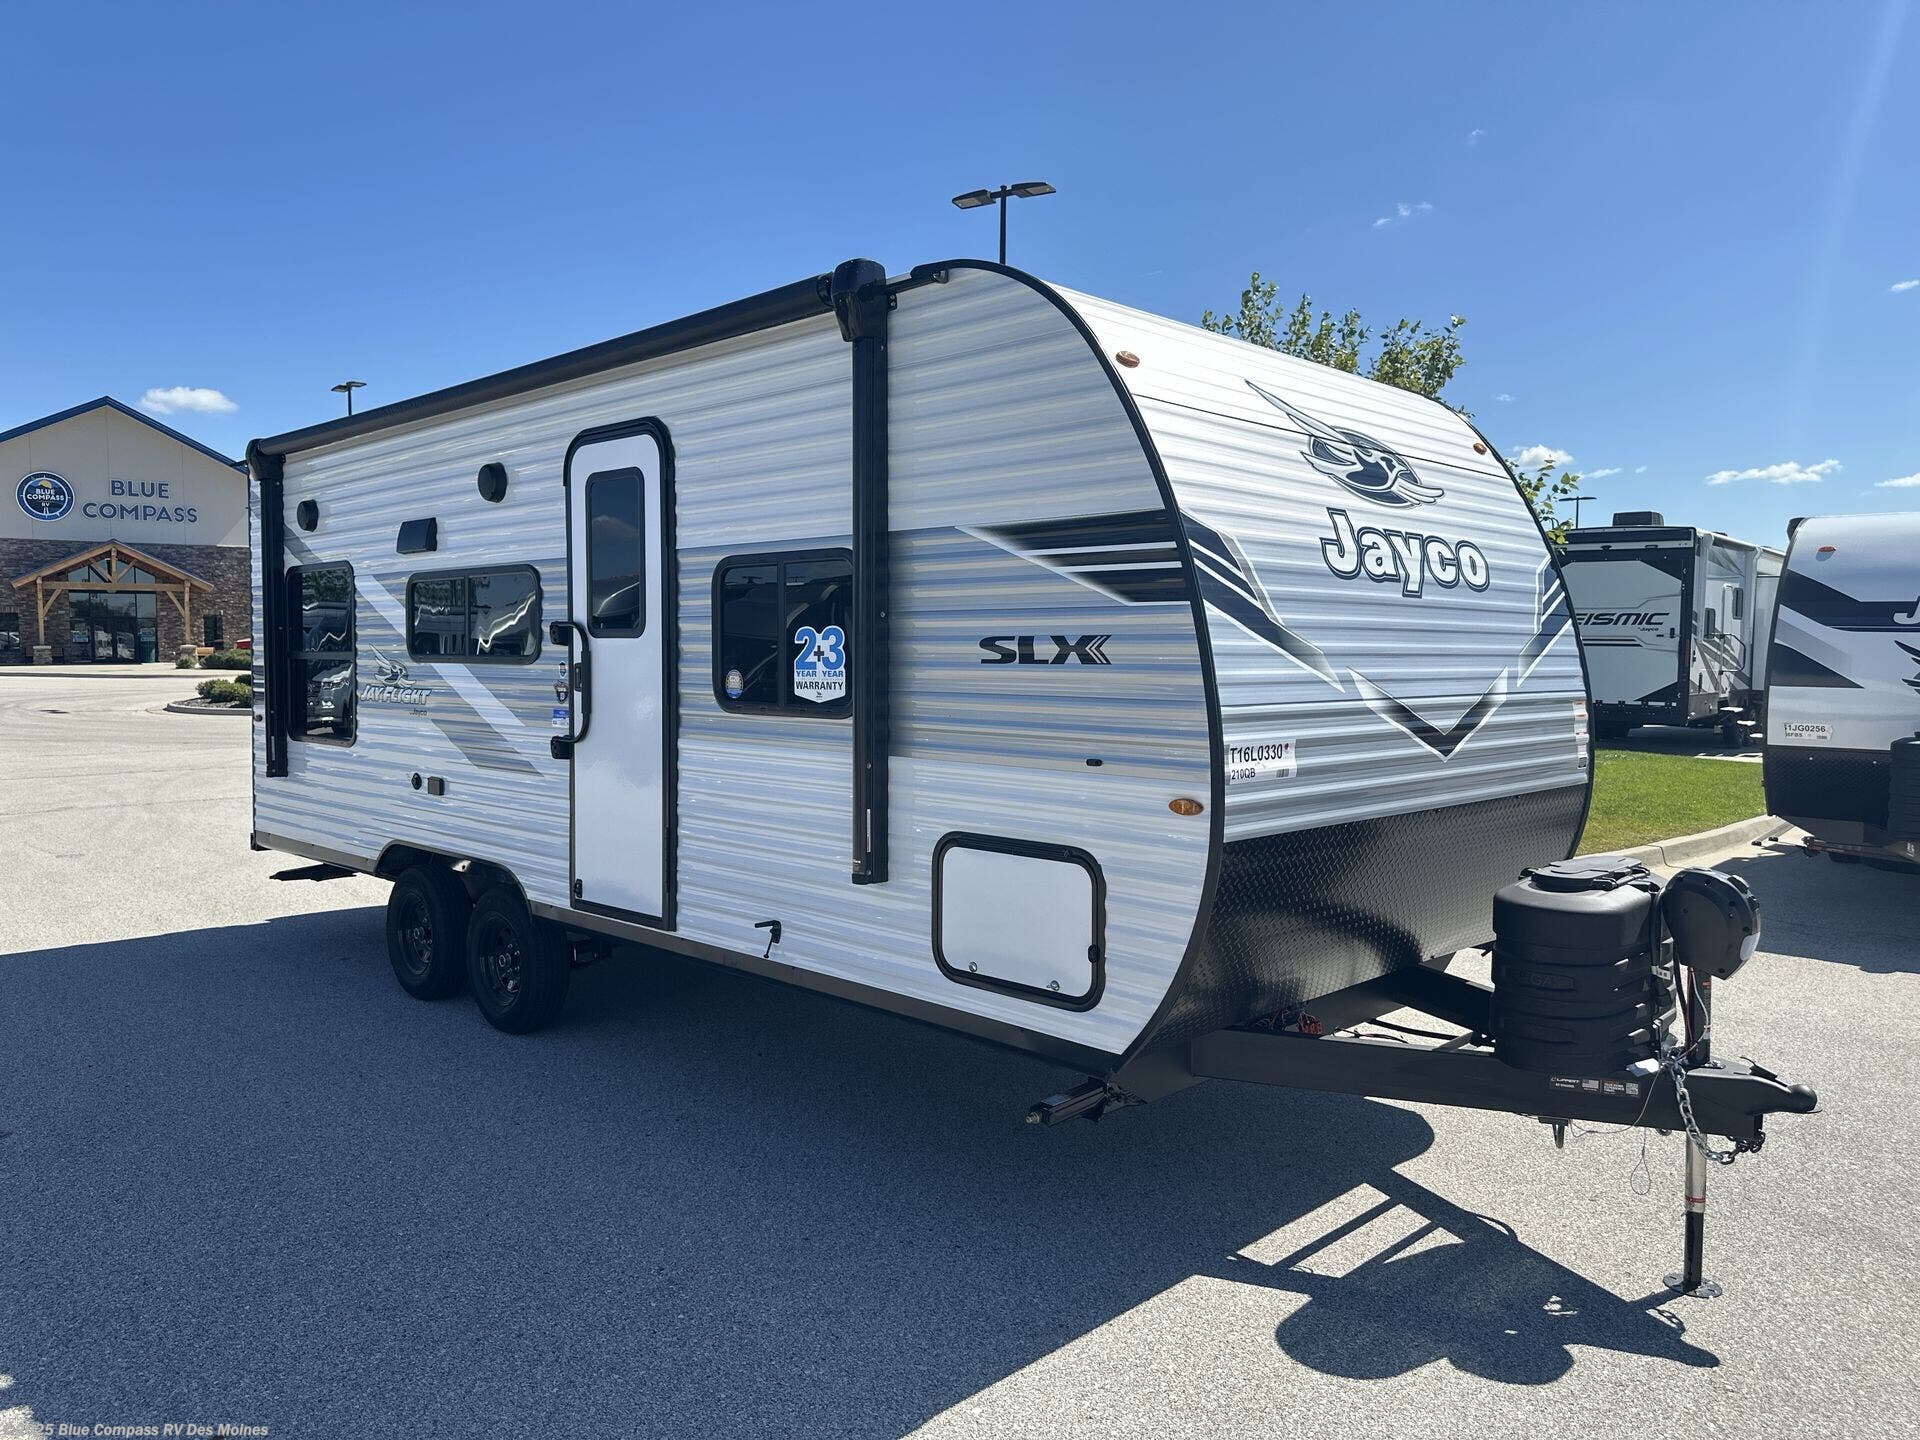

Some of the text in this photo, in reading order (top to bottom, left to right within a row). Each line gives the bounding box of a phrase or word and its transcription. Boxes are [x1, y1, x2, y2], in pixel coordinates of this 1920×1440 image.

[110, 480, 169, 499] BLUE
[82, 503, 198, 523] COMPASS
[1319, 507, 1490, 599] Jayco
[1576, 613, 1670, 626] EISMIC
[979, 634, 1112, 665] SLX
[796, 681, 844, 690] WARRANTY
[1230, 744, 1283, 763] T16L0330
[1231, 767, 1256, 780] 210QB
